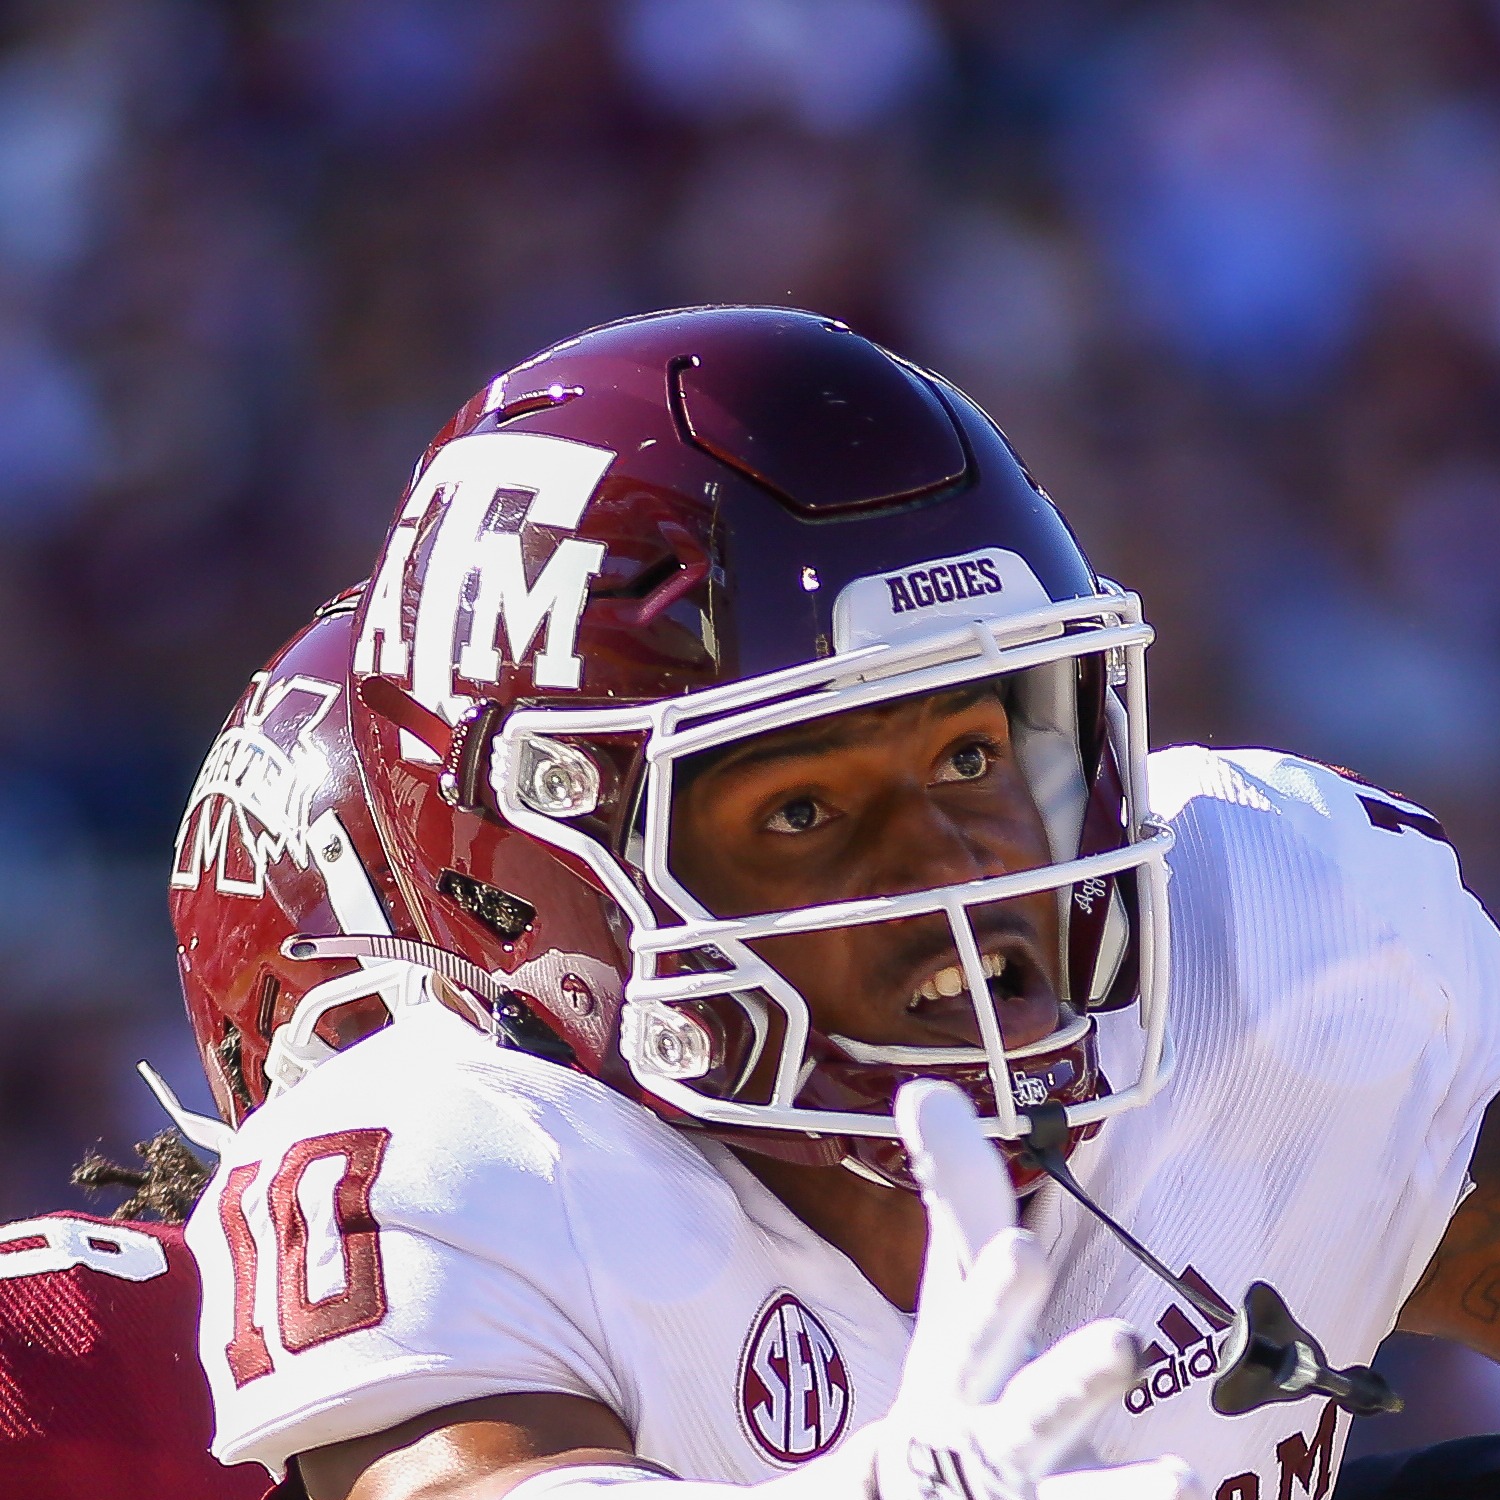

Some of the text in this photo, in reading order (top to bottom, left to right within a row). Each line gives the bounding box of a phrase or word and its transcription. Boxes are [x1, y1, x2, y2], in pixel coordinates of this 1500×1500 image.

[885, 557, 1003, 614] AGGIES
[218, 1127, 392, 1390] 10
[748, 1302, 848, 1455] SEC
[1125, 1335, 1228, 1414] adid
